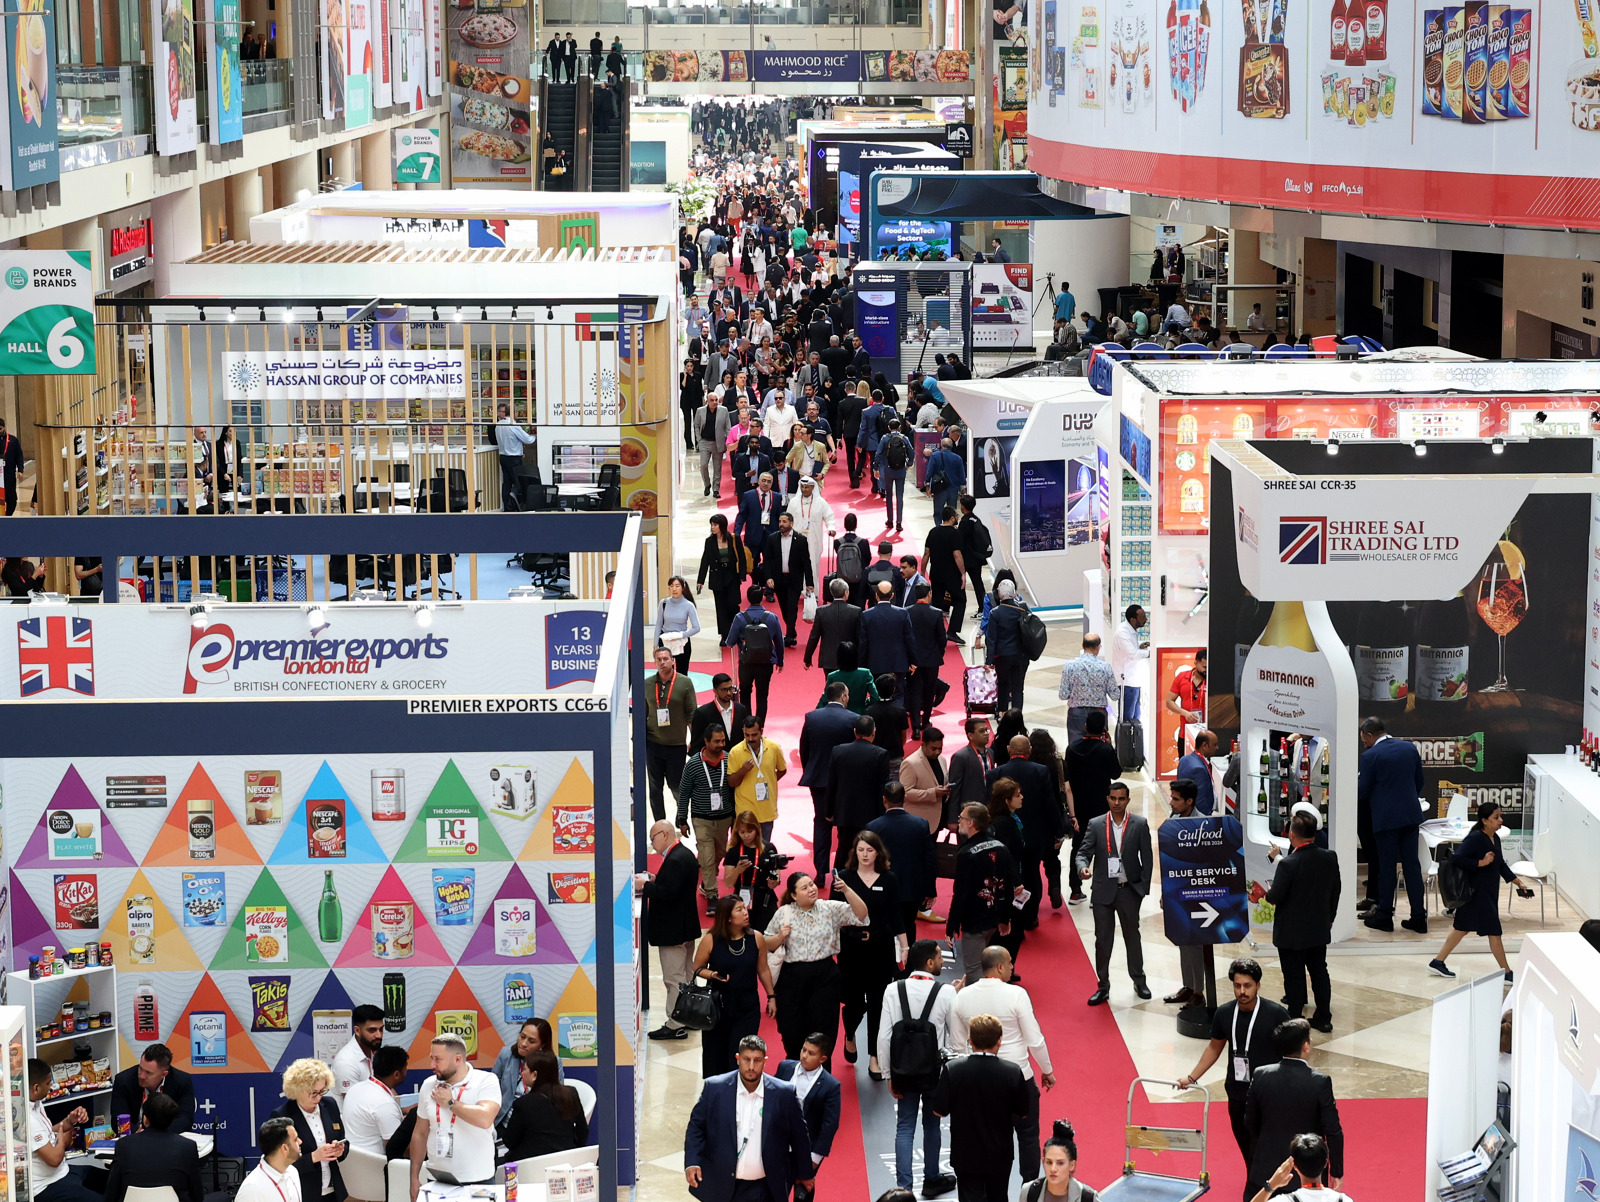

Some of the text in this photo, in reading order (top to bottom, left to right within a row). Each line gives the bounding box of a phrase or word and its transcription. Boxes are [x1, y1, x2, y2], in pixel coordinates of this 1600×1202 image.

[1179, 26, 1196, 54] ICEE
[1425, 31, 1443, 45] CHOCO
[1444, 28, 1464, 44] CHOCO
[1465, 25, 1487, 42] CHOCO
[1488, 28, 1509, 44] CHOCO
[1510, 31, 1530, 46] CHOCO
[1425, 40, 1442, 54] TOM
[1446, 39, 1462, 55] TOM
[1466, 36, 1485, 53] TOM
[1489, 39, 1507, 54] TOM
[1511, 41, 1529, 55] TOM
[764, 57, 845, 67] MAHMOOD RICE
[780, 68, 821, 77] محمود
[420, 157, 434, 180] 7
[1321, 184, 1339, 193] IFFCO
[33, 269, 72, 278] POWER
[33, 279, 77, 289] BRANDS
[8, 317, 85, 369] HALL 6
[266, 356, 462, 374] مجموعة شركات حسني
[266, 374, 463, 386] HASSANI GROUP OF COMPANIES
[425, 385, 462, 394] Since 1912
[1263, 480, 1356, 490] SHREE SAI CCR-35
[1329, 521, 1425, 535] SHREE SAI
[1329, 536, 1459, 551] TRADING LTD
[1360, 553, 1417, 561] WHOLESALER
[1419, 553, 1431, 561] OF
[571, 627, 591, 640] 13
[233, 633, 449, 670] premier exports
[554, 645, 592, 656] YEARS
[1360, 649, 1404, 659] BRITANNICA
[1420, 648, 1464, 659] BRITANNICA
[283, 656, 369, 674] london ltd
[551, 659, 600, 670] BUSINE
[1260, 669, 1315, 688] BRITANNICA
[234, 679, 447, 692] BRITISH CONFECTIONERY & GROCERY
[1274, 689, 1300, 701] Sparkling
[410, 698, 608, 712] PREMIER EXPORTS CC6-6
[1267, 703, 1306, 718] Celebration Drink
[1419, 742, 1455, 761] ORCE
[247, 784, 280, 794] NESCAFÉ
[382, 783, 394, 793] illy
[1468, 787, 1522, 808] FORCE
[438, 819, 467, 840] PG
[571, 827, 587, 835] Pods
[1177, 820, 1223, 847] Gulfood
[194, 851, 210, 860] 200g
[1168, 867, 1238, 879] BLUE SERVICE
[187, 877, 221, 889] OREO
[555, 876, 590, 889] Digestives
[1190, 877, 1217, 886] DESK
[62, 882, 93, 903] KitKat
[438, 884, 467, 898] Hubba
[446, 889, 470, 902] Bubba
[449, 904, 470, 912] PROTEIN
[128, 911, 153, 921] alpro
[380, 912, 404, 920] Cerelac
[501, 912, 530, 923] sma
[56, 922, 73, 930] 330g
[253, 983, 287, 1008] Takis
[505, 986, 532, 1001] FANTA
[138, 995, 154, 1033] PRIME
[462, 1014, 473, 1023] 400g
[193, 1022, 223, 1032] Aptamil
[317, 1023, 349, 1031] Kendamil
[441, 1025, 472, 1036] NIDO
[571, 1022, 593, 1032] Heinz
[194, 1041, 201, 1055] 1
[88, 1131, 106, 1143] Alpen
